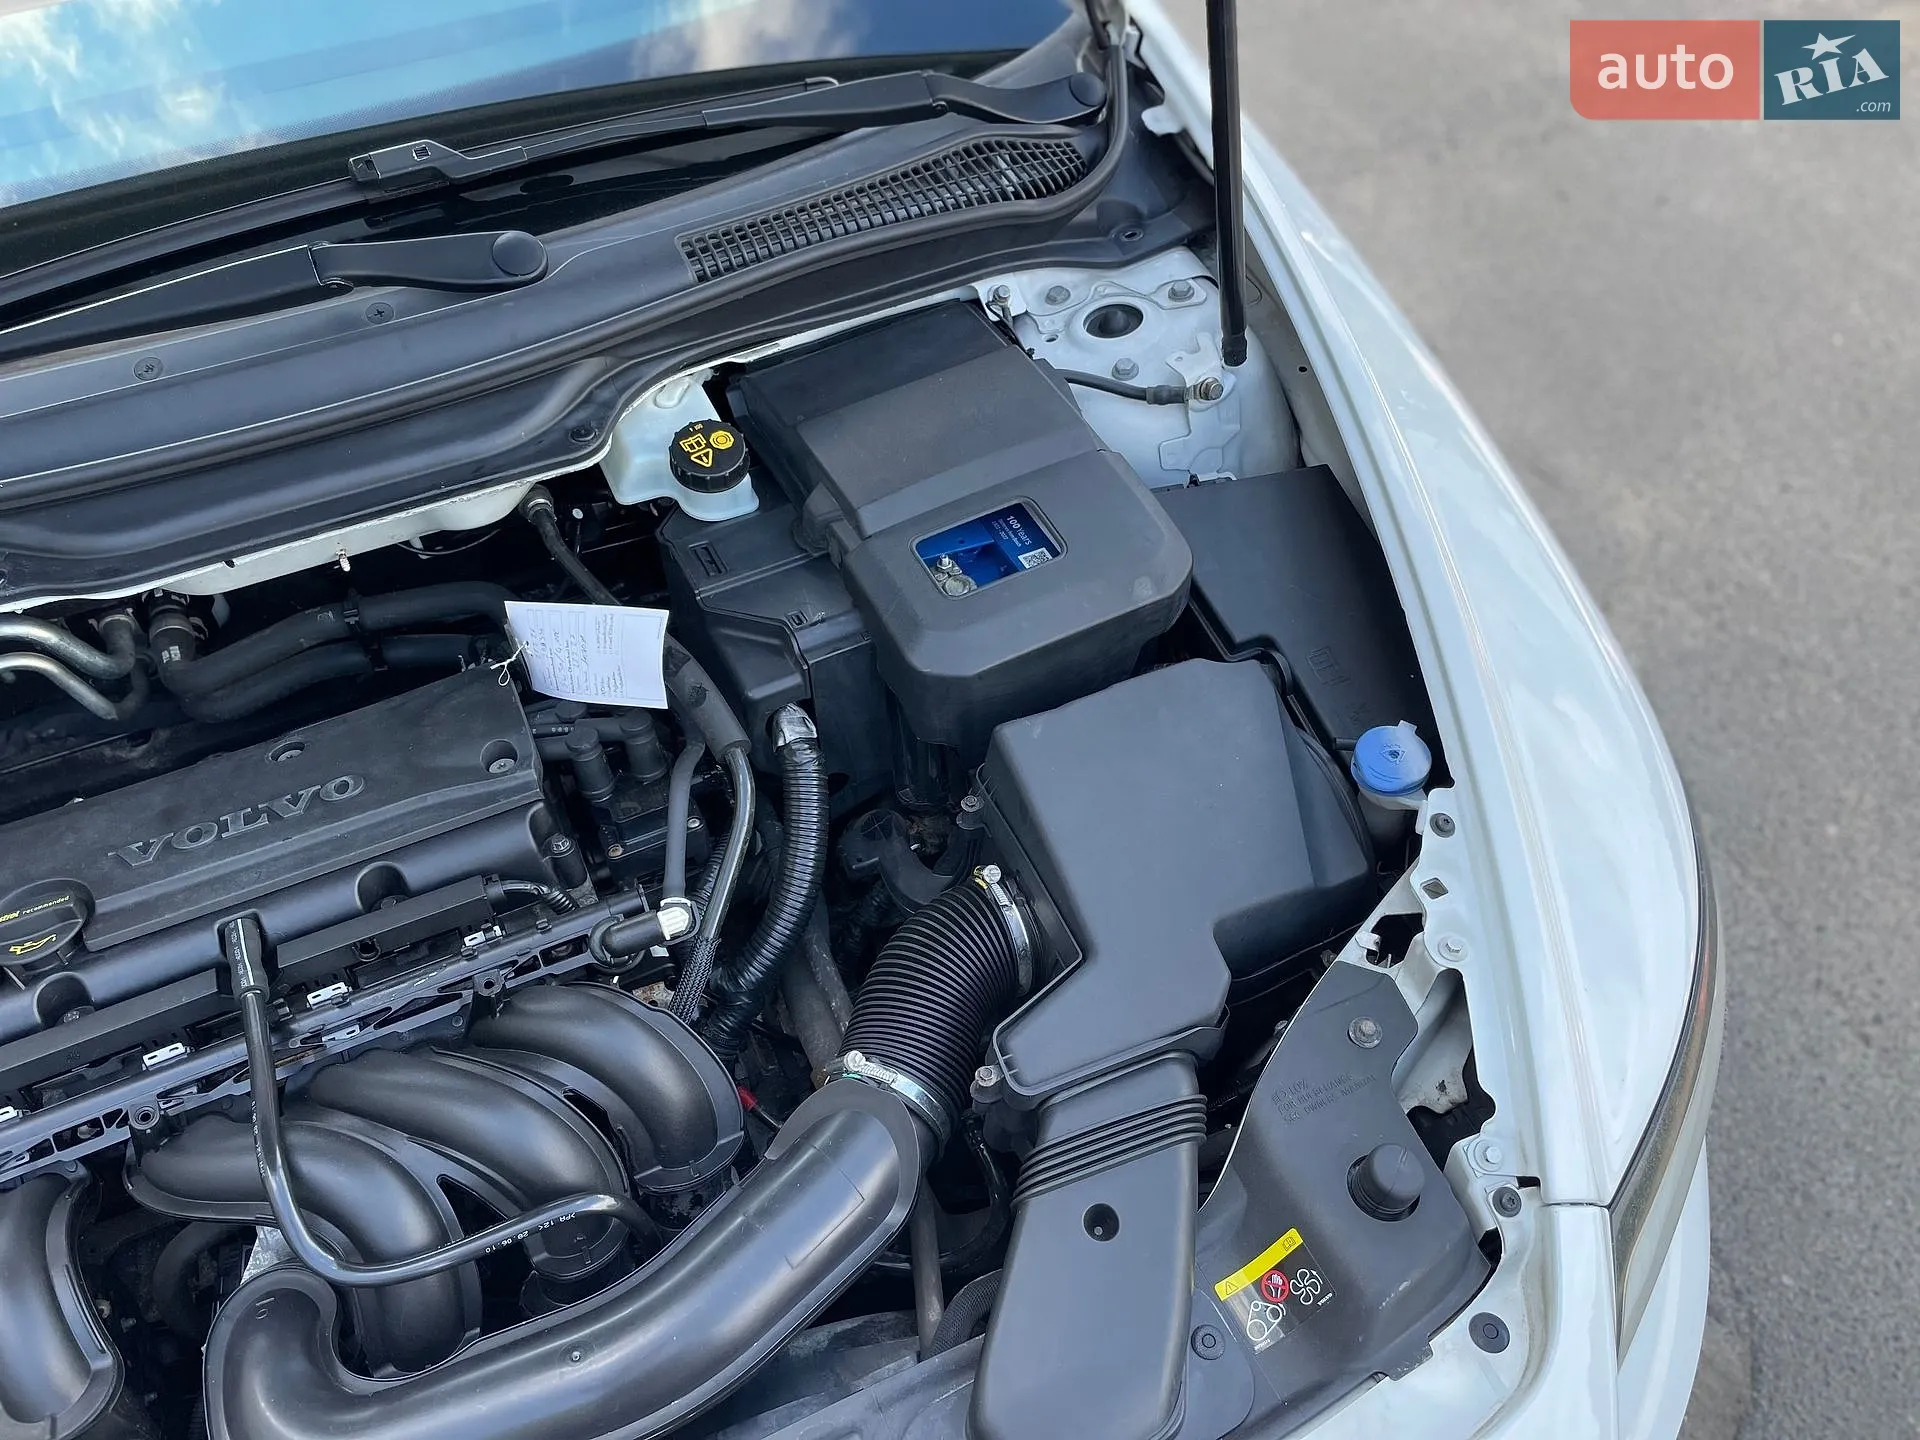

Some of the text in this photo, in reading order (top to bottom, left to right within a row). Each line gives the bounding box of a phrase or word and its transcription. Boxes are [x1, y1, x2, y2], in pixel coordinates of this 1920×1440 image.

[1007, 515, 1032, 545] 100 Years
[108, 774, 365, 867] VOLVO
[22, 895, 70, 915] recommended
